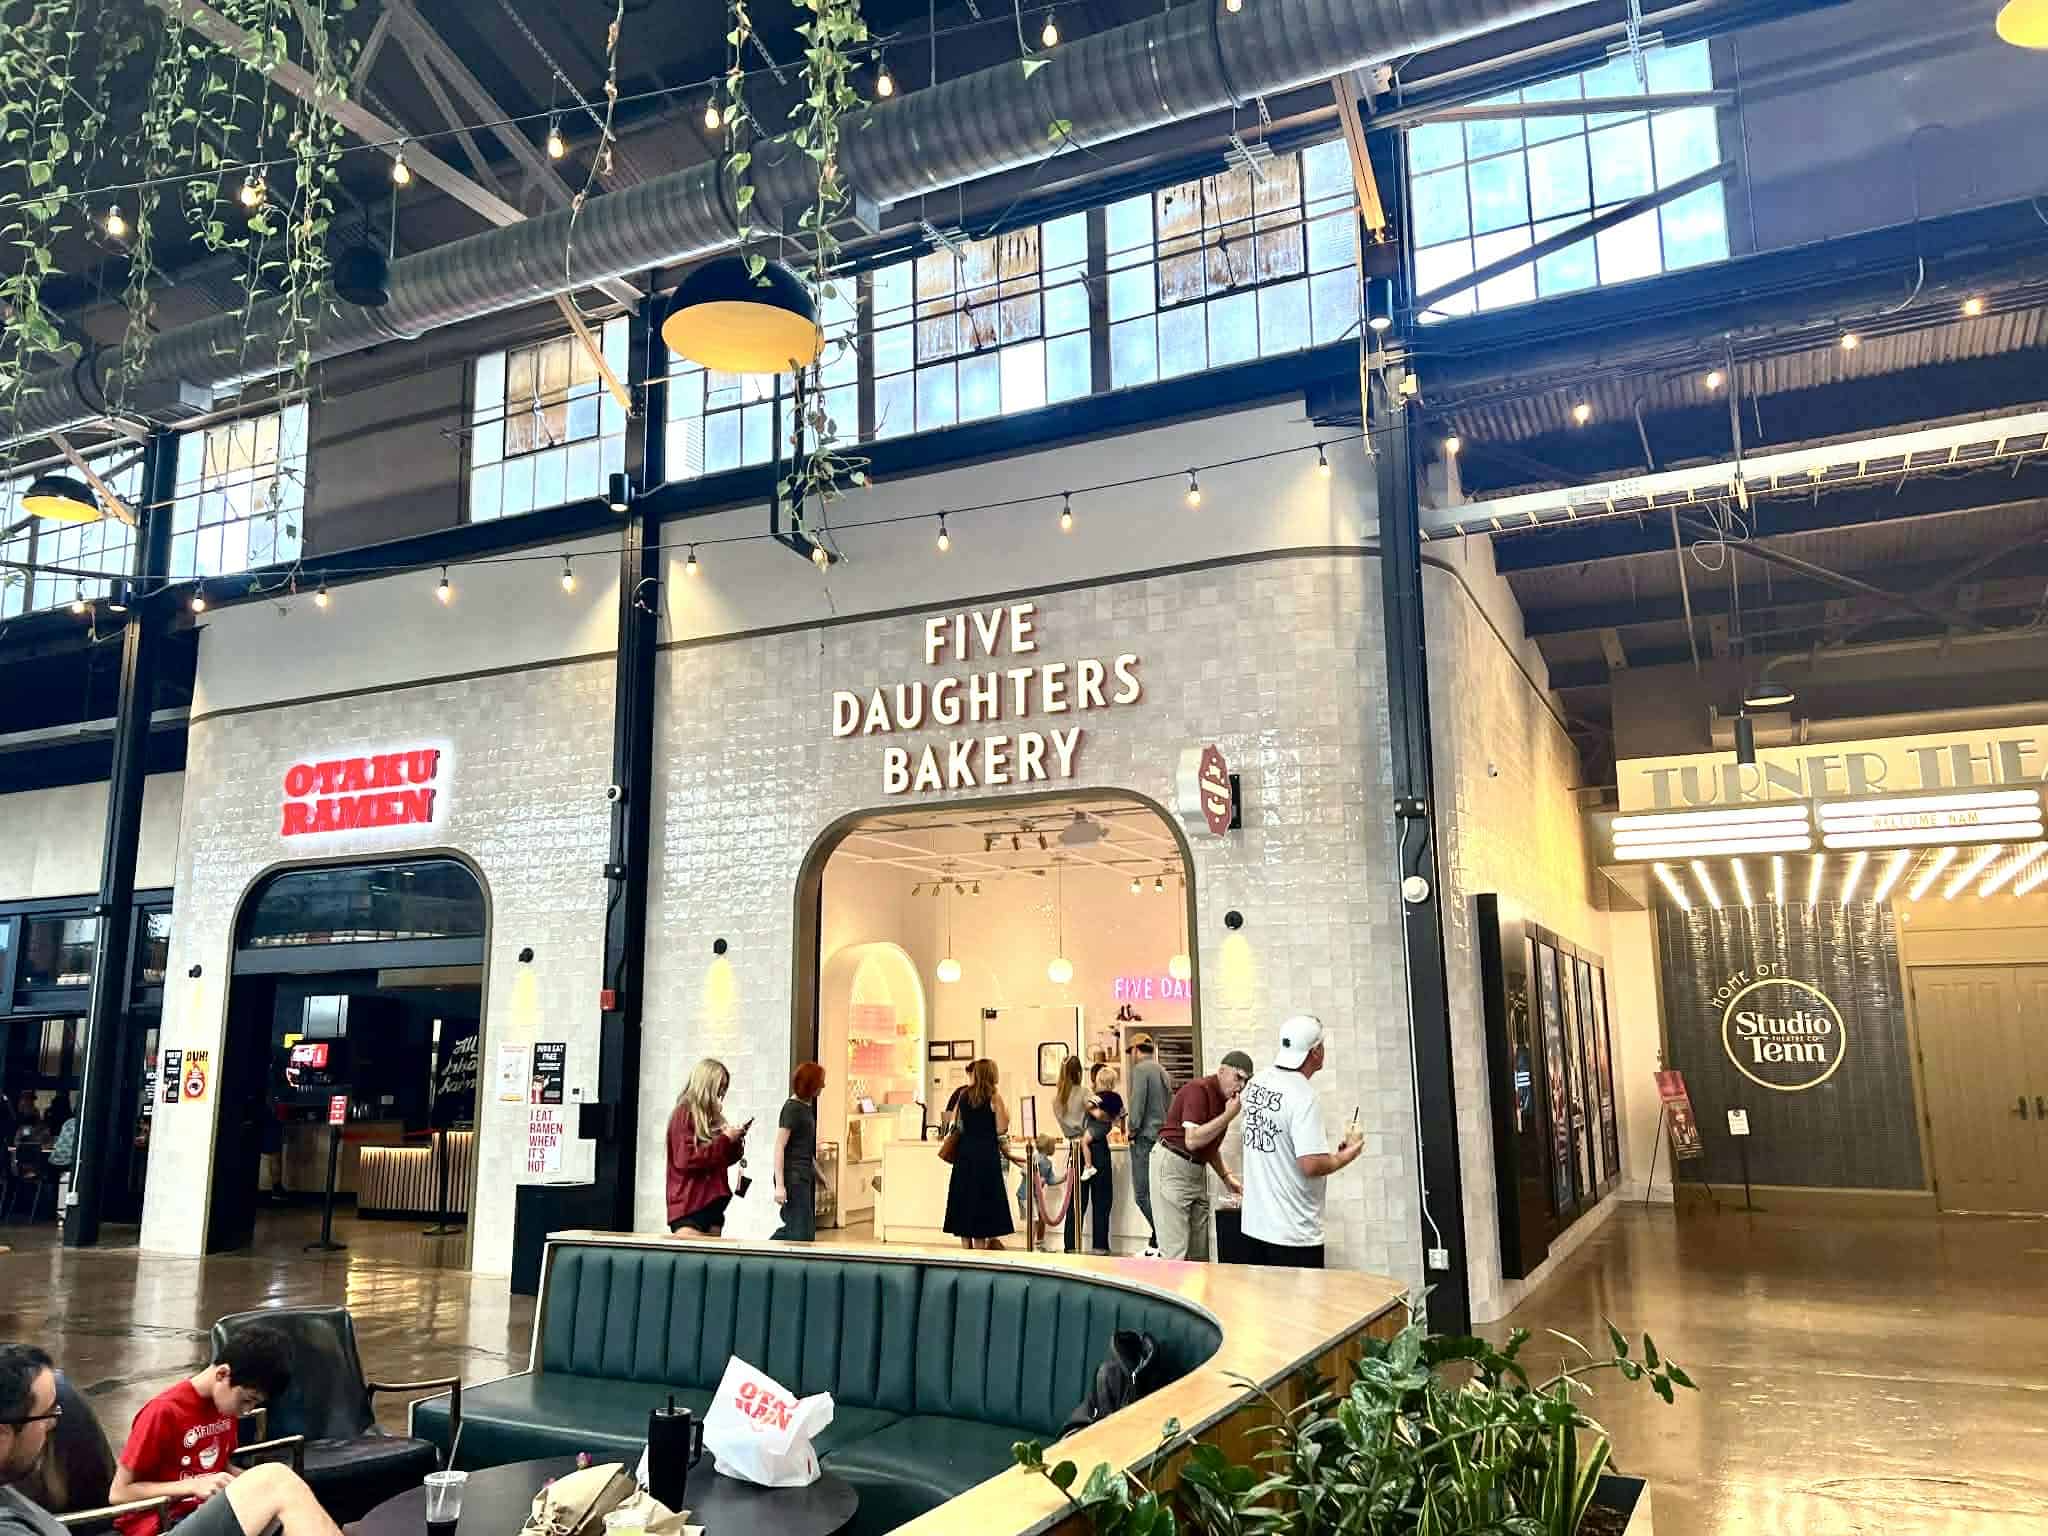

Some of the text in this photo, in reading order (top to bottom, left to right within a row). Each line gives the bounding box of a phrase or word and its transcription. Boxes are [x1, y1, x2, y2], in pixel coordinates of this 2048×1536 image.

[925, 602, 1037, 665] FIVE
[832, 653, 1143, 738] DAUGHTERS
[285, 749, 440, 798] OTAKU
[882, 726, 1081, 794] BAKERY
[1641, 738, 2048, 809] TURNER THE
[281, 788, 436, 836] RAMEN
[1114, 977, 1153, 1000] FIVE
[1711, 969, 1751, 1009] HOME
[1735, 1010, 1832, 1036] Studio
[186, 1050, 209, 1062] DUH!
[1743, 1036, 1827, 1063] Tenn
[529, 1122, 563, 1135] RAMEN
[536, 1110, 553, 1121] EAT
[529, 1135, 557, 1147] WHEN
